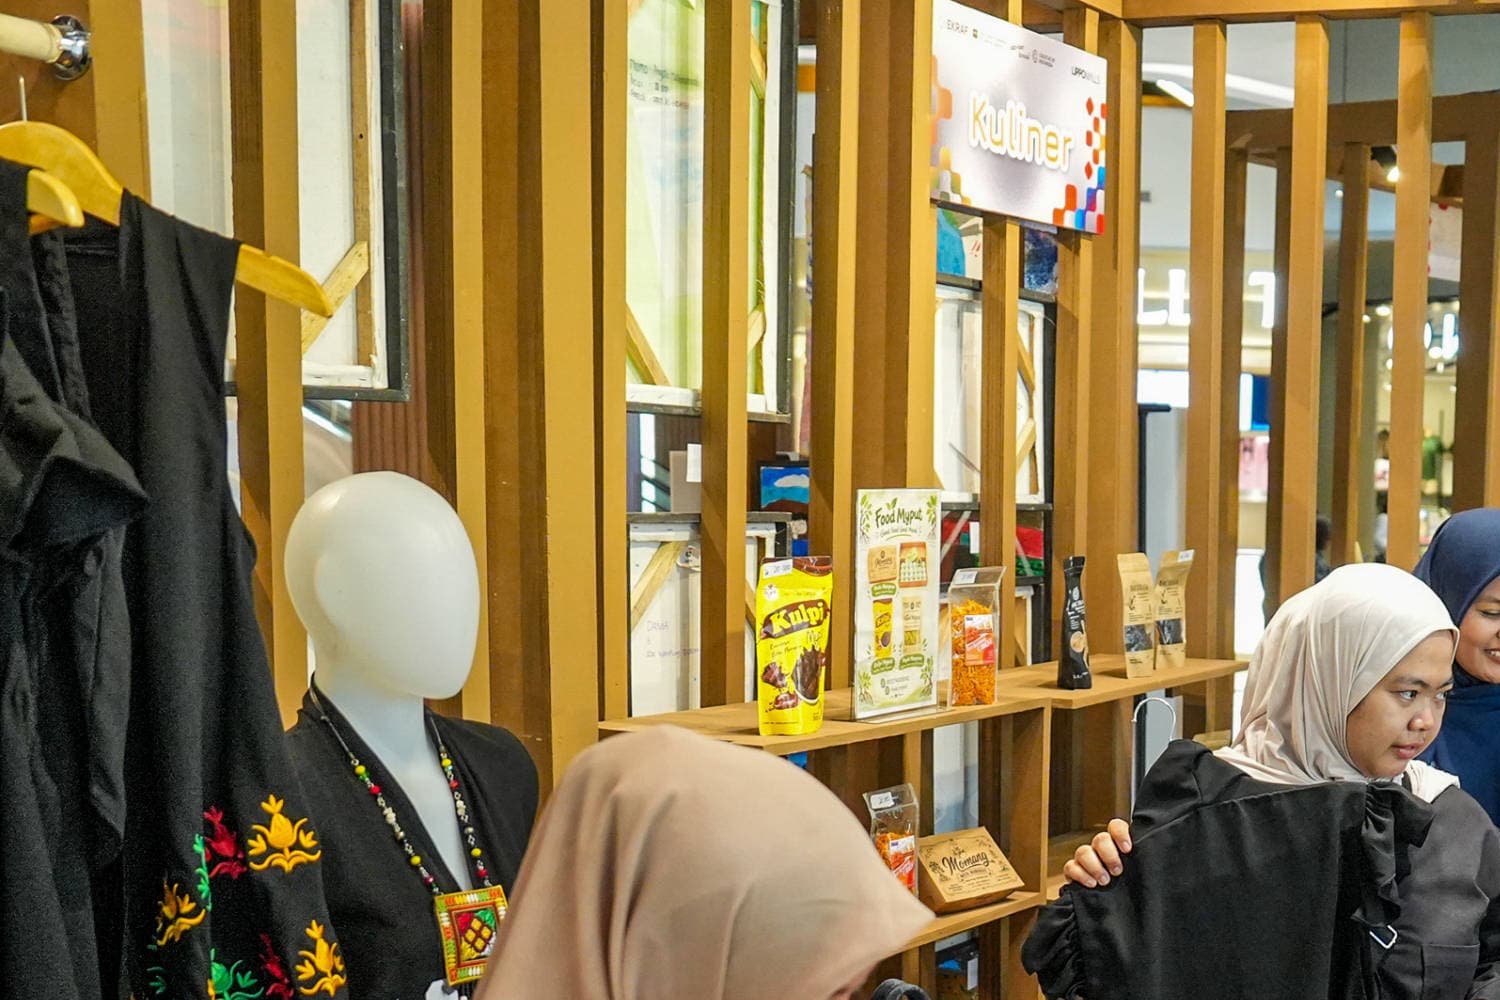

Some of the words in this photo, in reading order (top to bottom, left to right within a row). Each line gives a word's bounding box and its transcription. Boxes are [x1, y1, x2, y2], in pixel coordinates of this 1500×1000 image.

[970, 94, 1073, 168] Kuliner
[875, 507, 896, 528] Food
[770, 602, 824, 635] Kulpi
